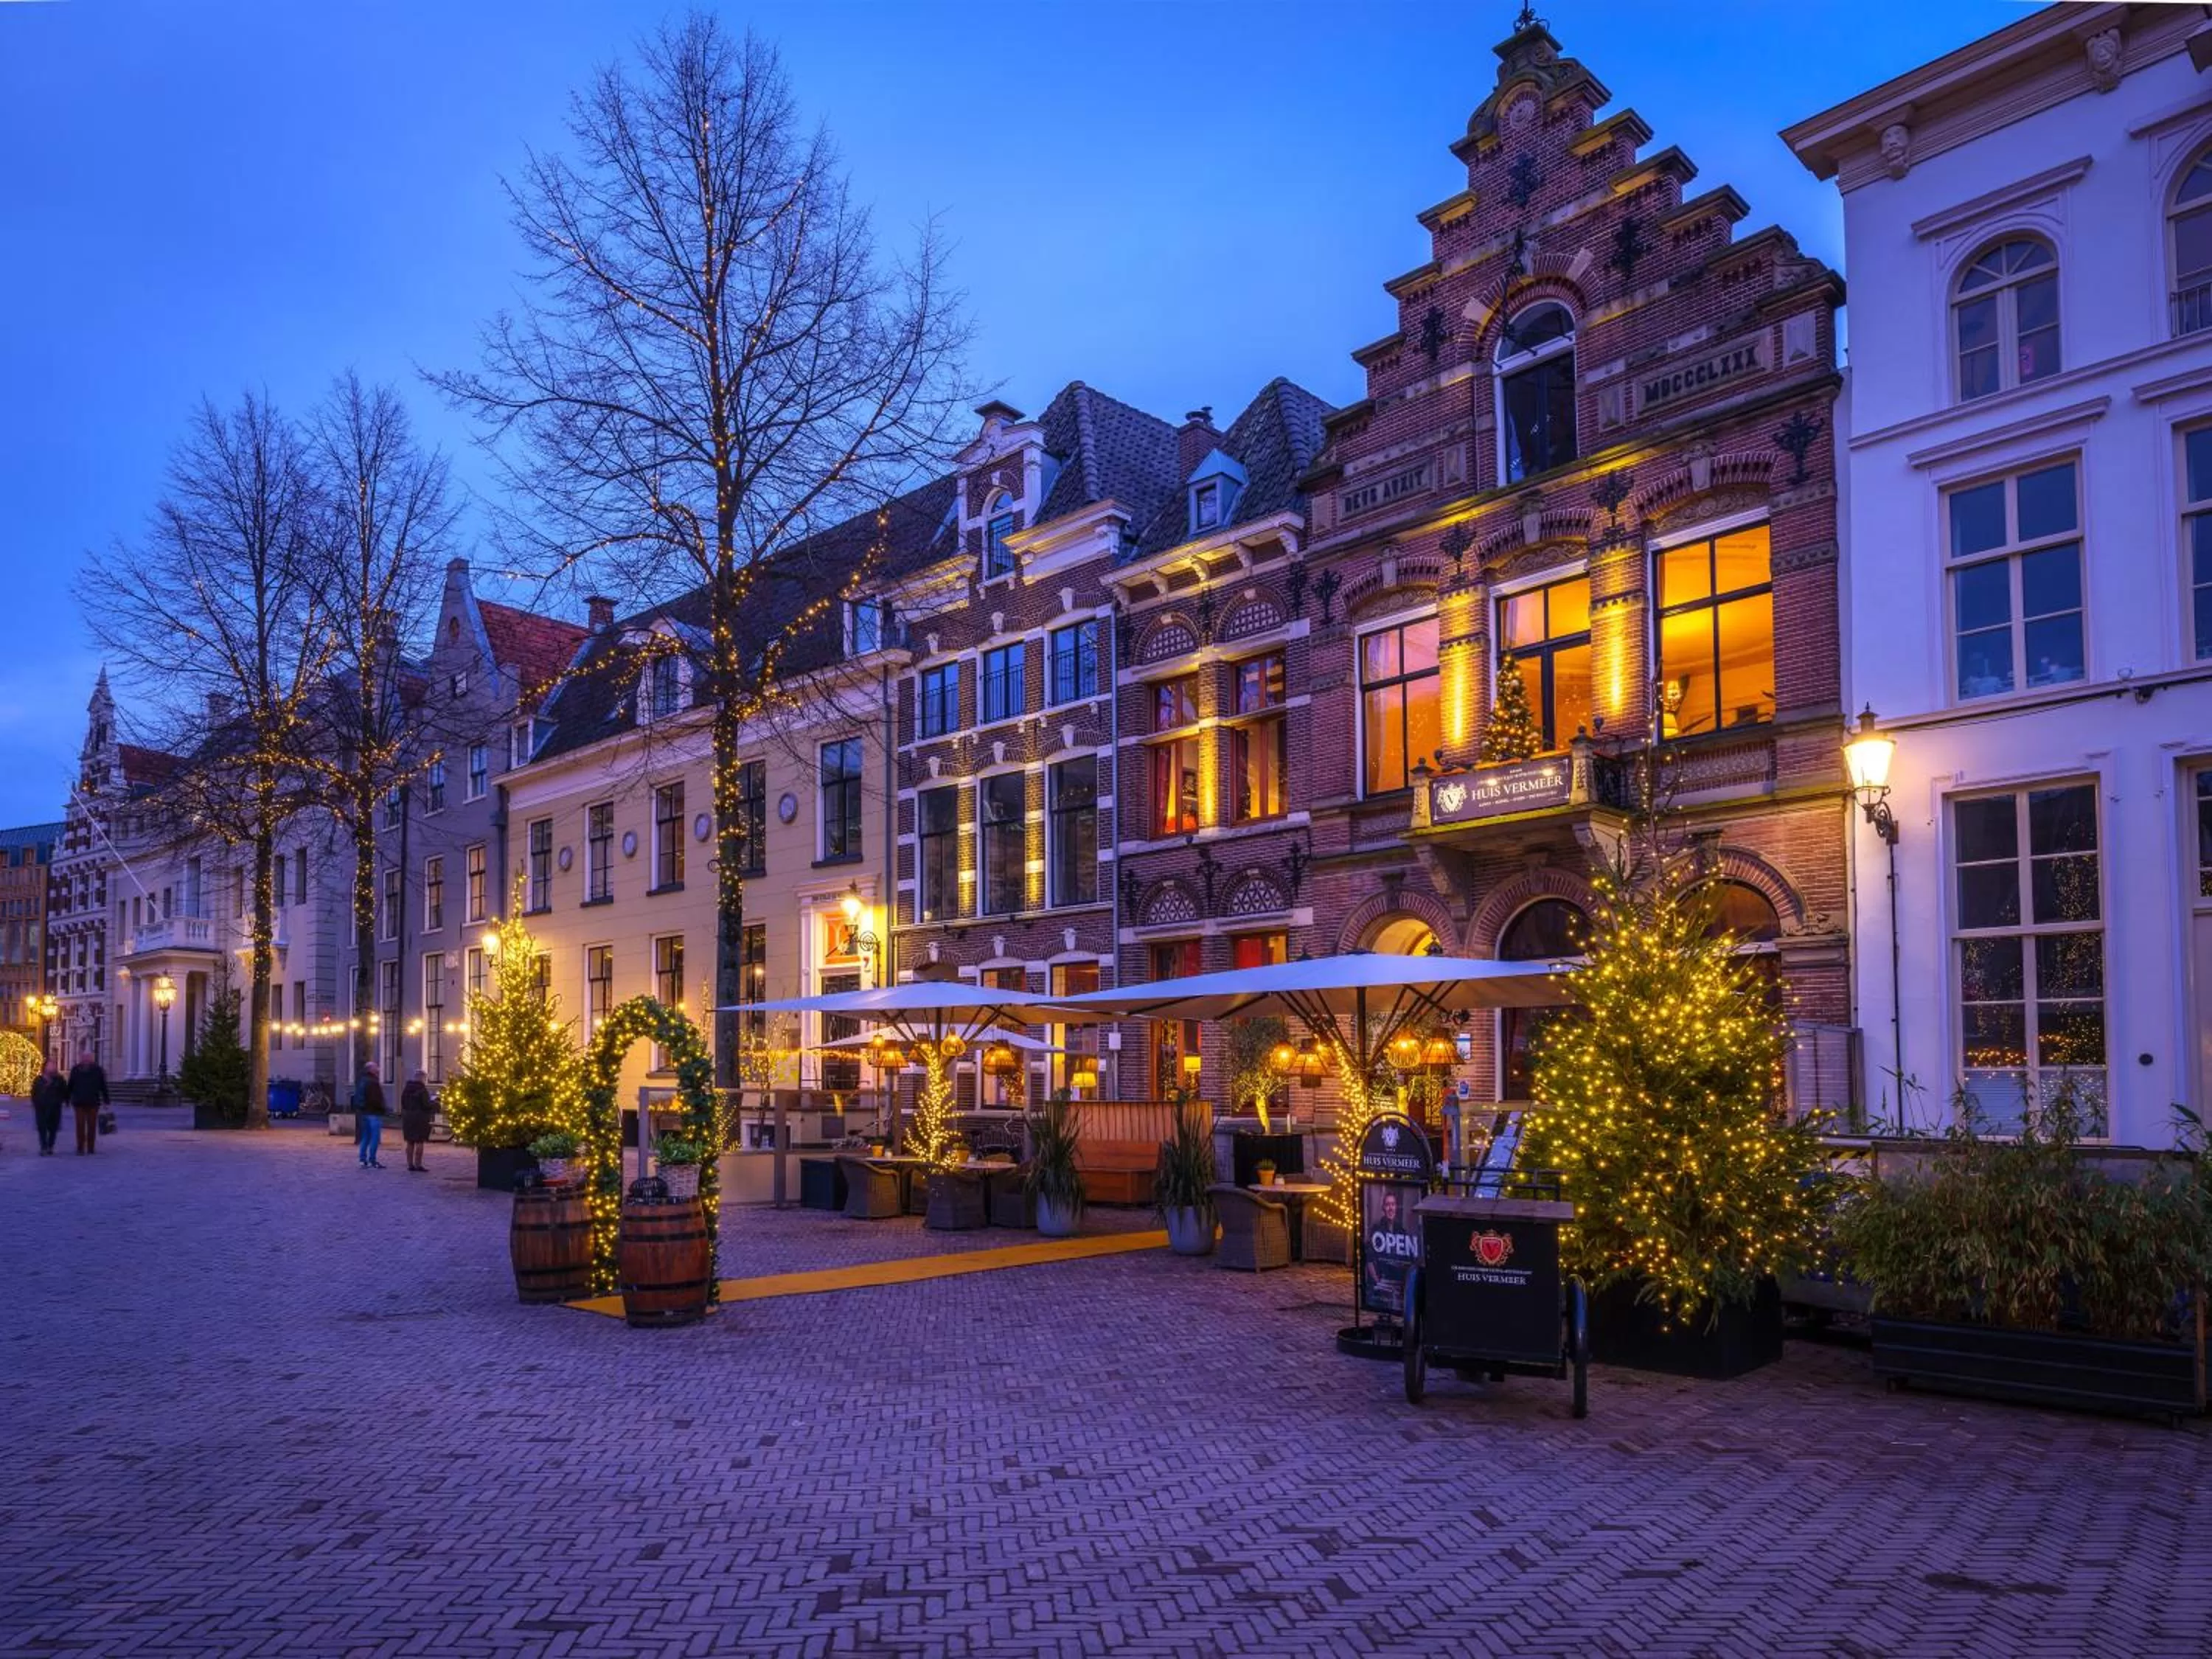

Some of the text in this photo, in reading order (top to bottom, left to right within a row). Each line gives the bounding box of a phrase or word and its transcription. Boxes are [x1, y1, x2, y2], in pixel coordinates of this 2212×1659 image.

[1472, 786, 1500, 801] HUIS
[1503, 775, 1563, 794] VERMEER
[1363, 1155, 1381, 1166] HUIS
[1372, 1231, 1419, 1257] OPEN
[1458, 1273, 1526, 1284] HUIS VERMEER
